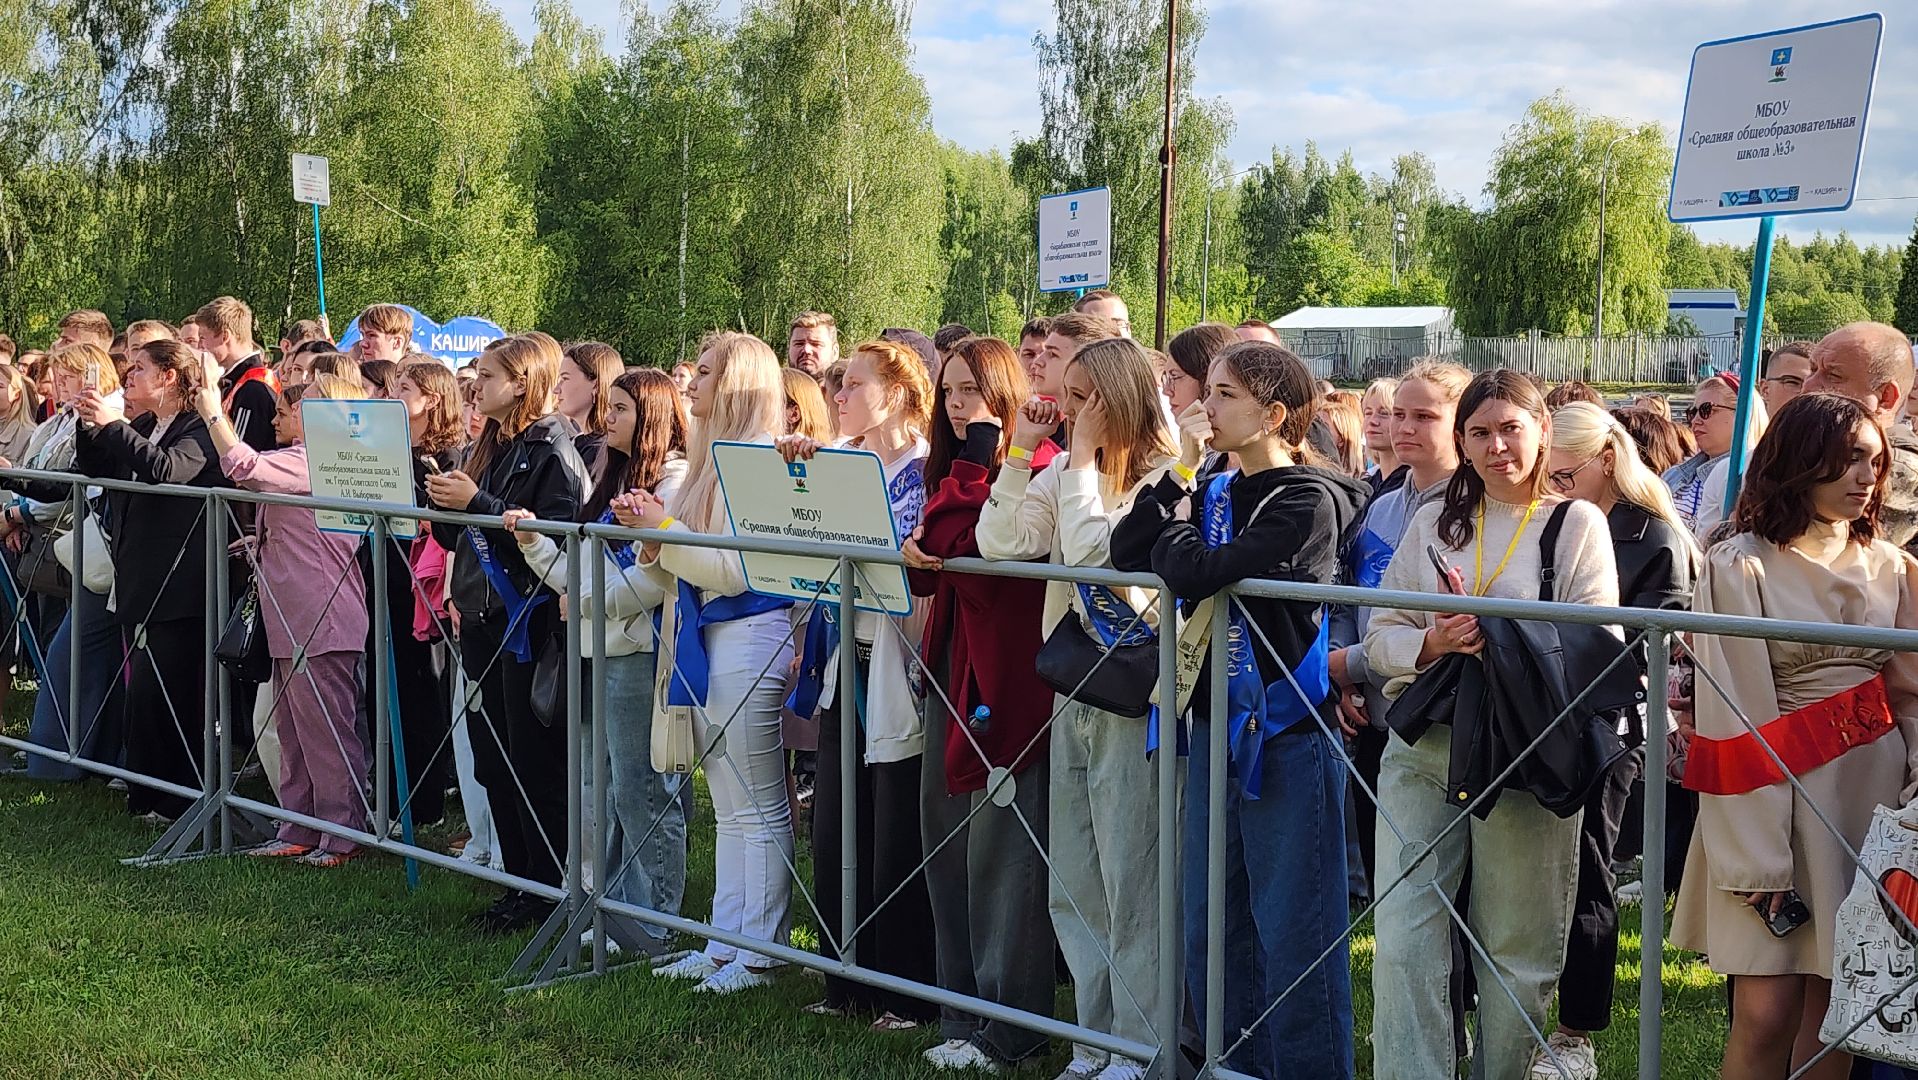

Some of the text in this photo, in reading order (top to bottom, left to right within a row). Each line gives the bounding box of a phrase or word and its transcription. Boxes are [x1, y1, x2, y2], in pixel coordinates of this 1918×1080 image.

[1754, 99, 1791, 119] МБОУ
[1688, 114, 1857, 149] «Средняя общеобразовательная
[1736, 140, 1795, 161] школа №3»
[431, 333, 498, 353] КАШИР
[337, 451, 353, 462] МБОУ
[374, 467, 391, 476] школа
[334, 476, 349, 488] Героя
[350, 477, 379, 488] Советского
[380, 479, 397, 490] Союза
[790, 506, 823, 523] МБОУ
[739, 518, 890, 548] «Средняя общеобразовательная
